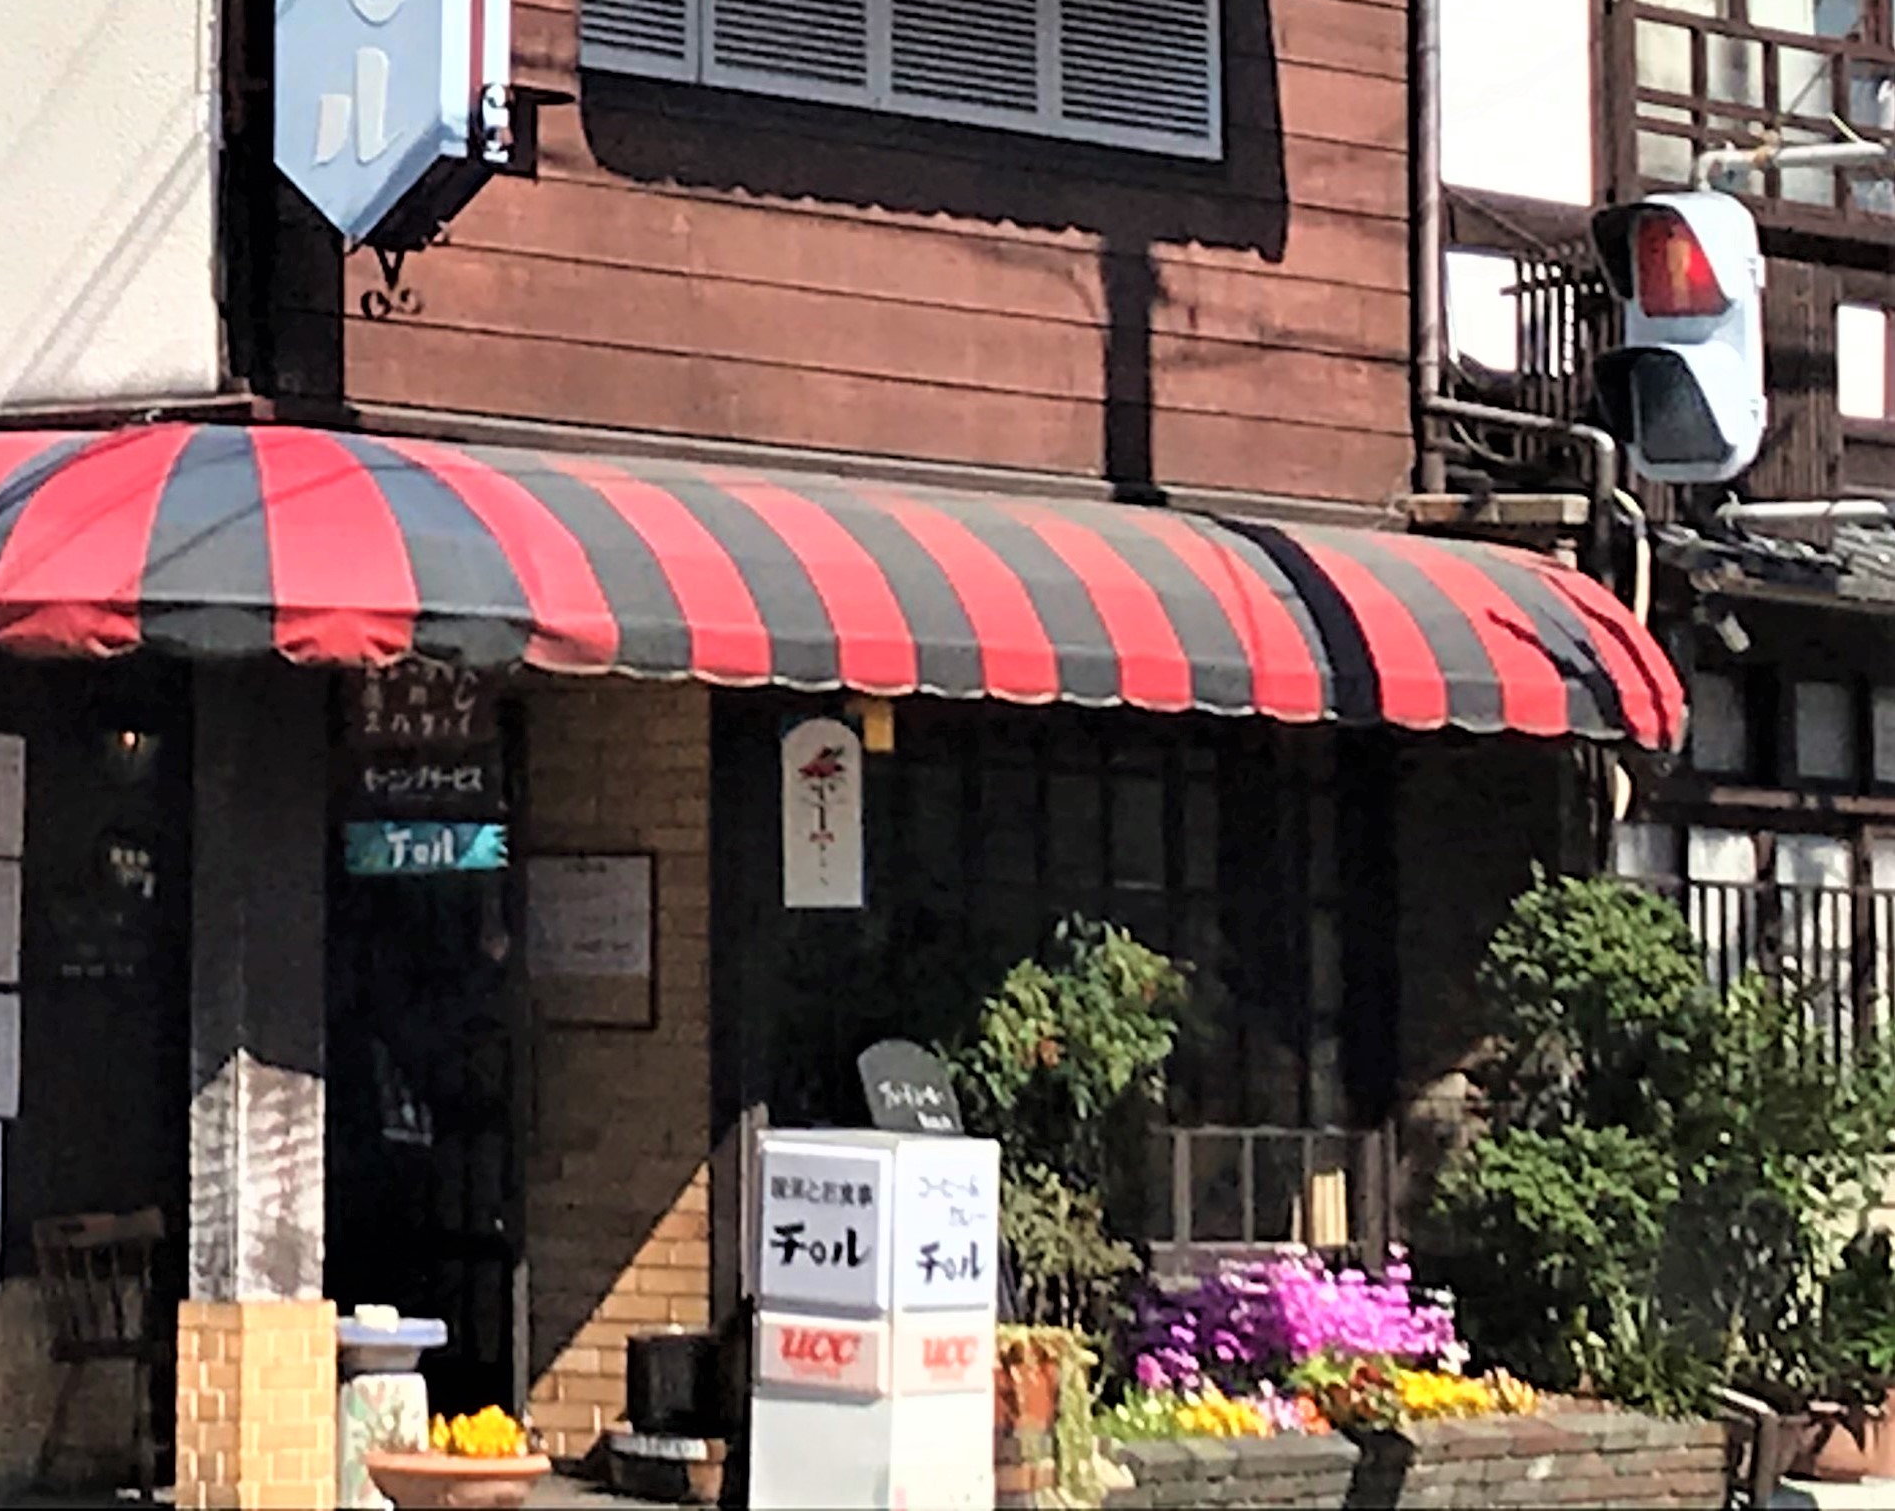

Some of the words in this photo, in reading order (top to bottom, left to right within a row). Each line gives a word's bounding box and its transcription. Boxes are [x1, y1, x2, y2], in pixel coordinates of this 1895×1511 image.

[769, 1220, 873, 1268] チロル
[915, 1239, 988, 1286] チロル
[778, 1324, 863, 1367] UCC
[921, 1335, 980, 1369] UCC
